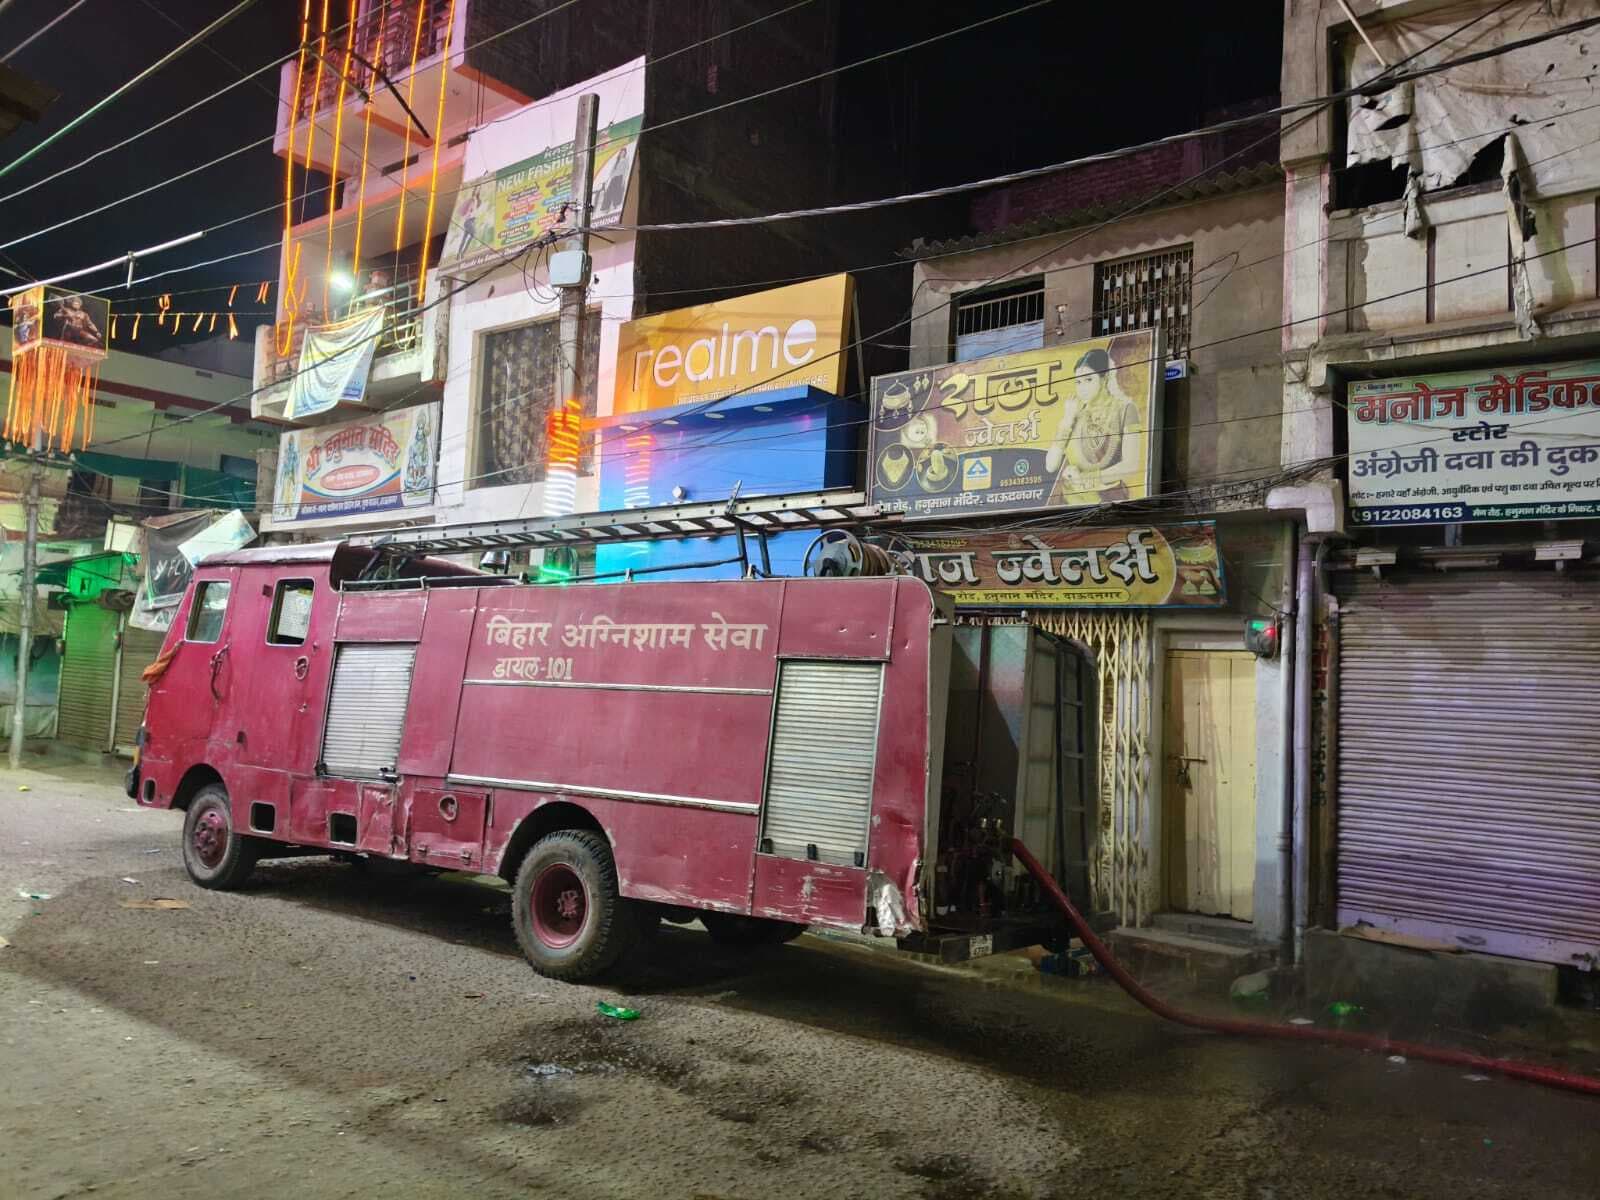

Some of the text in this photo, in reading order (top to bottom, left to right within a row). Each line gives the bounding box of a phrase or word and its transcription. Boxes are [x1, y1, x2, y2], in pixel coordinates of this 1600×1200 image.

[528, 157, 574, 180] FASHIO
[633, 319, 817, 391] realme
[939, 360, 1062, 421] राज
[1354, 382, 1468, 423] मनोज
[964, 410, 1041, 446] ज्वेलर्स
[1451, 421, 1509, 442] स्टोर
[306, 424, 400, 476] श्री हनुमान मंदिर
[1352, 447, 1440, 478] अंग्रेजी
[1444, 451, 1495, 471] दवा
[1499, 440, 1541, 467] की
[914, 497, 951, 514] हनुमान
[1362, 507, 1463, 521] 9122084163
[992, 529, 1157, 585] ज्वेलर्स
[984, 592, 1021, 602] हनुमान
[1062, 591, 1122, 601] दाऊदनगर
[486, 611, 768, 652] बिहार अग्निशाम सेवा
[493, 657, 573, 680] डायल-101
